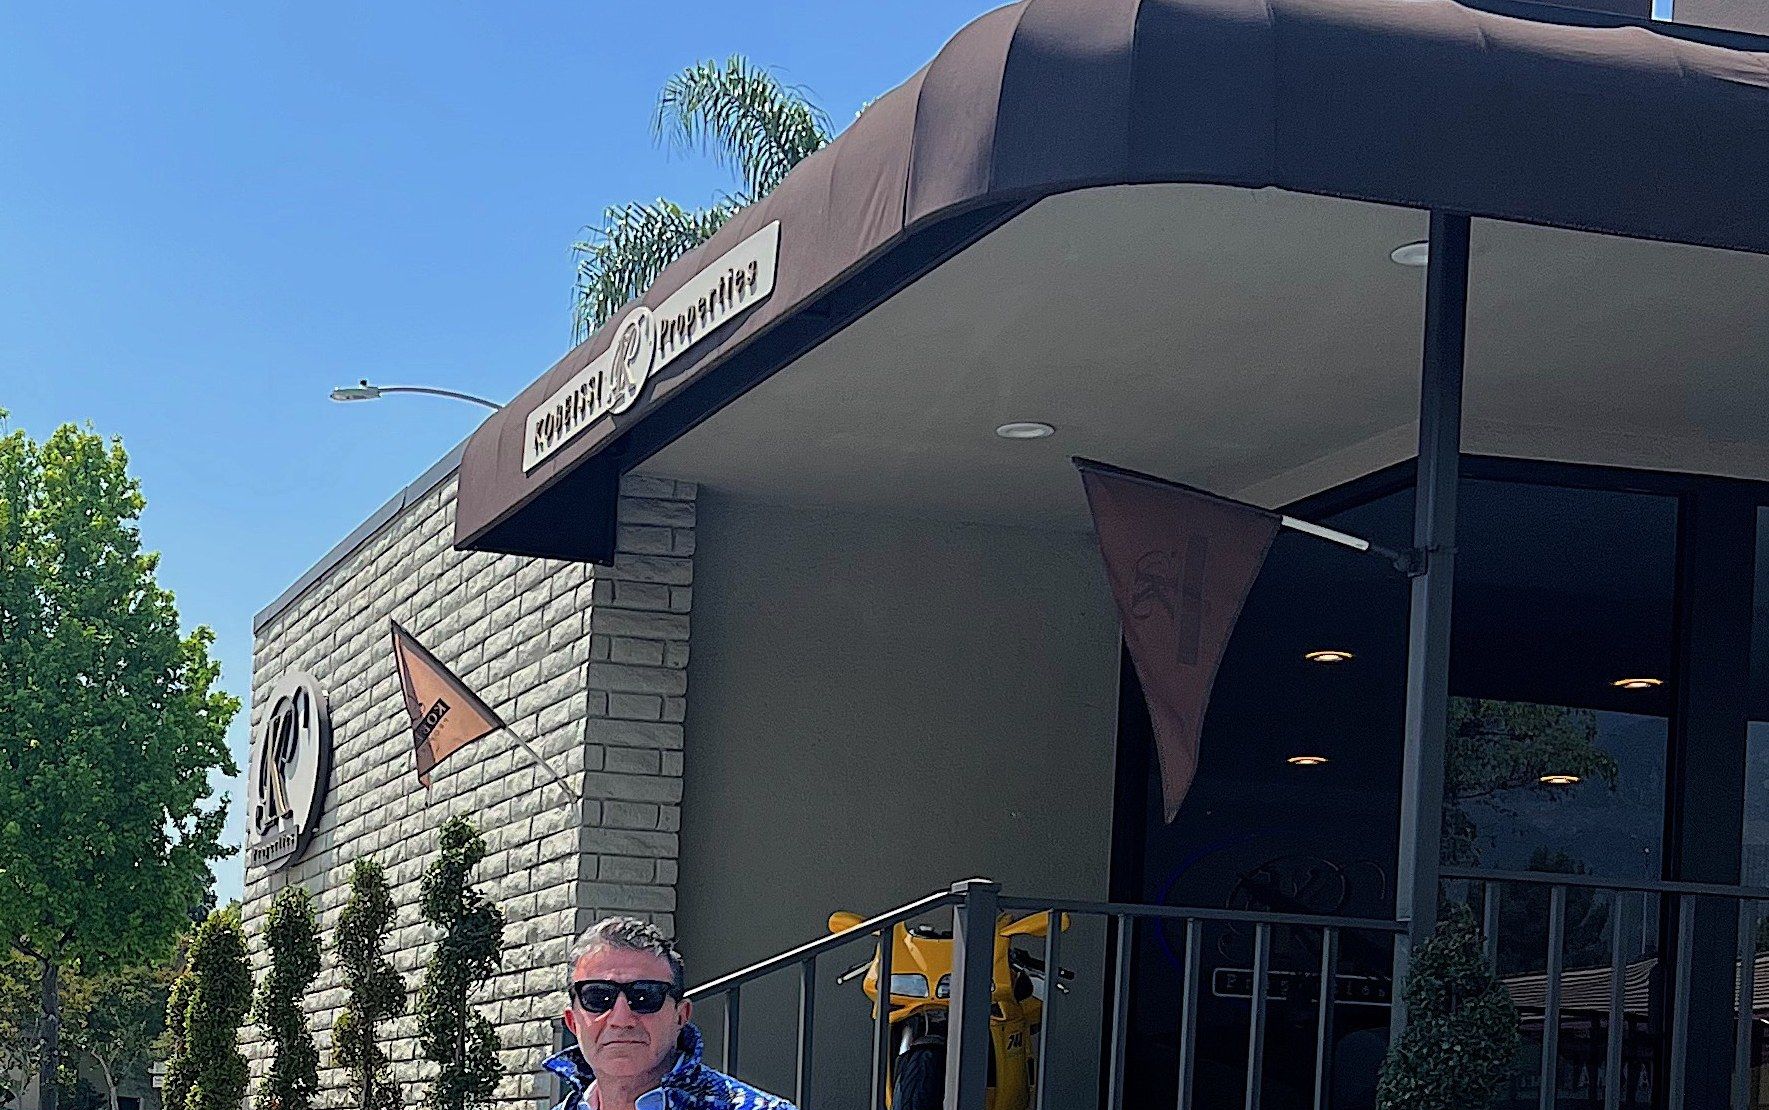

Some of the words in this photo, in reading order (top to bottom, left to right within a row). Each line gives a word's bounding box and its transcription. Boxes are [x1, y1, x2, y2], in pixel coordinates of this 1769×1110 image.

[532, 370, 603, 457] KOBEISSI
[660, 258, 757, 353] Properties
[416, 702, 447, 741] KOB
